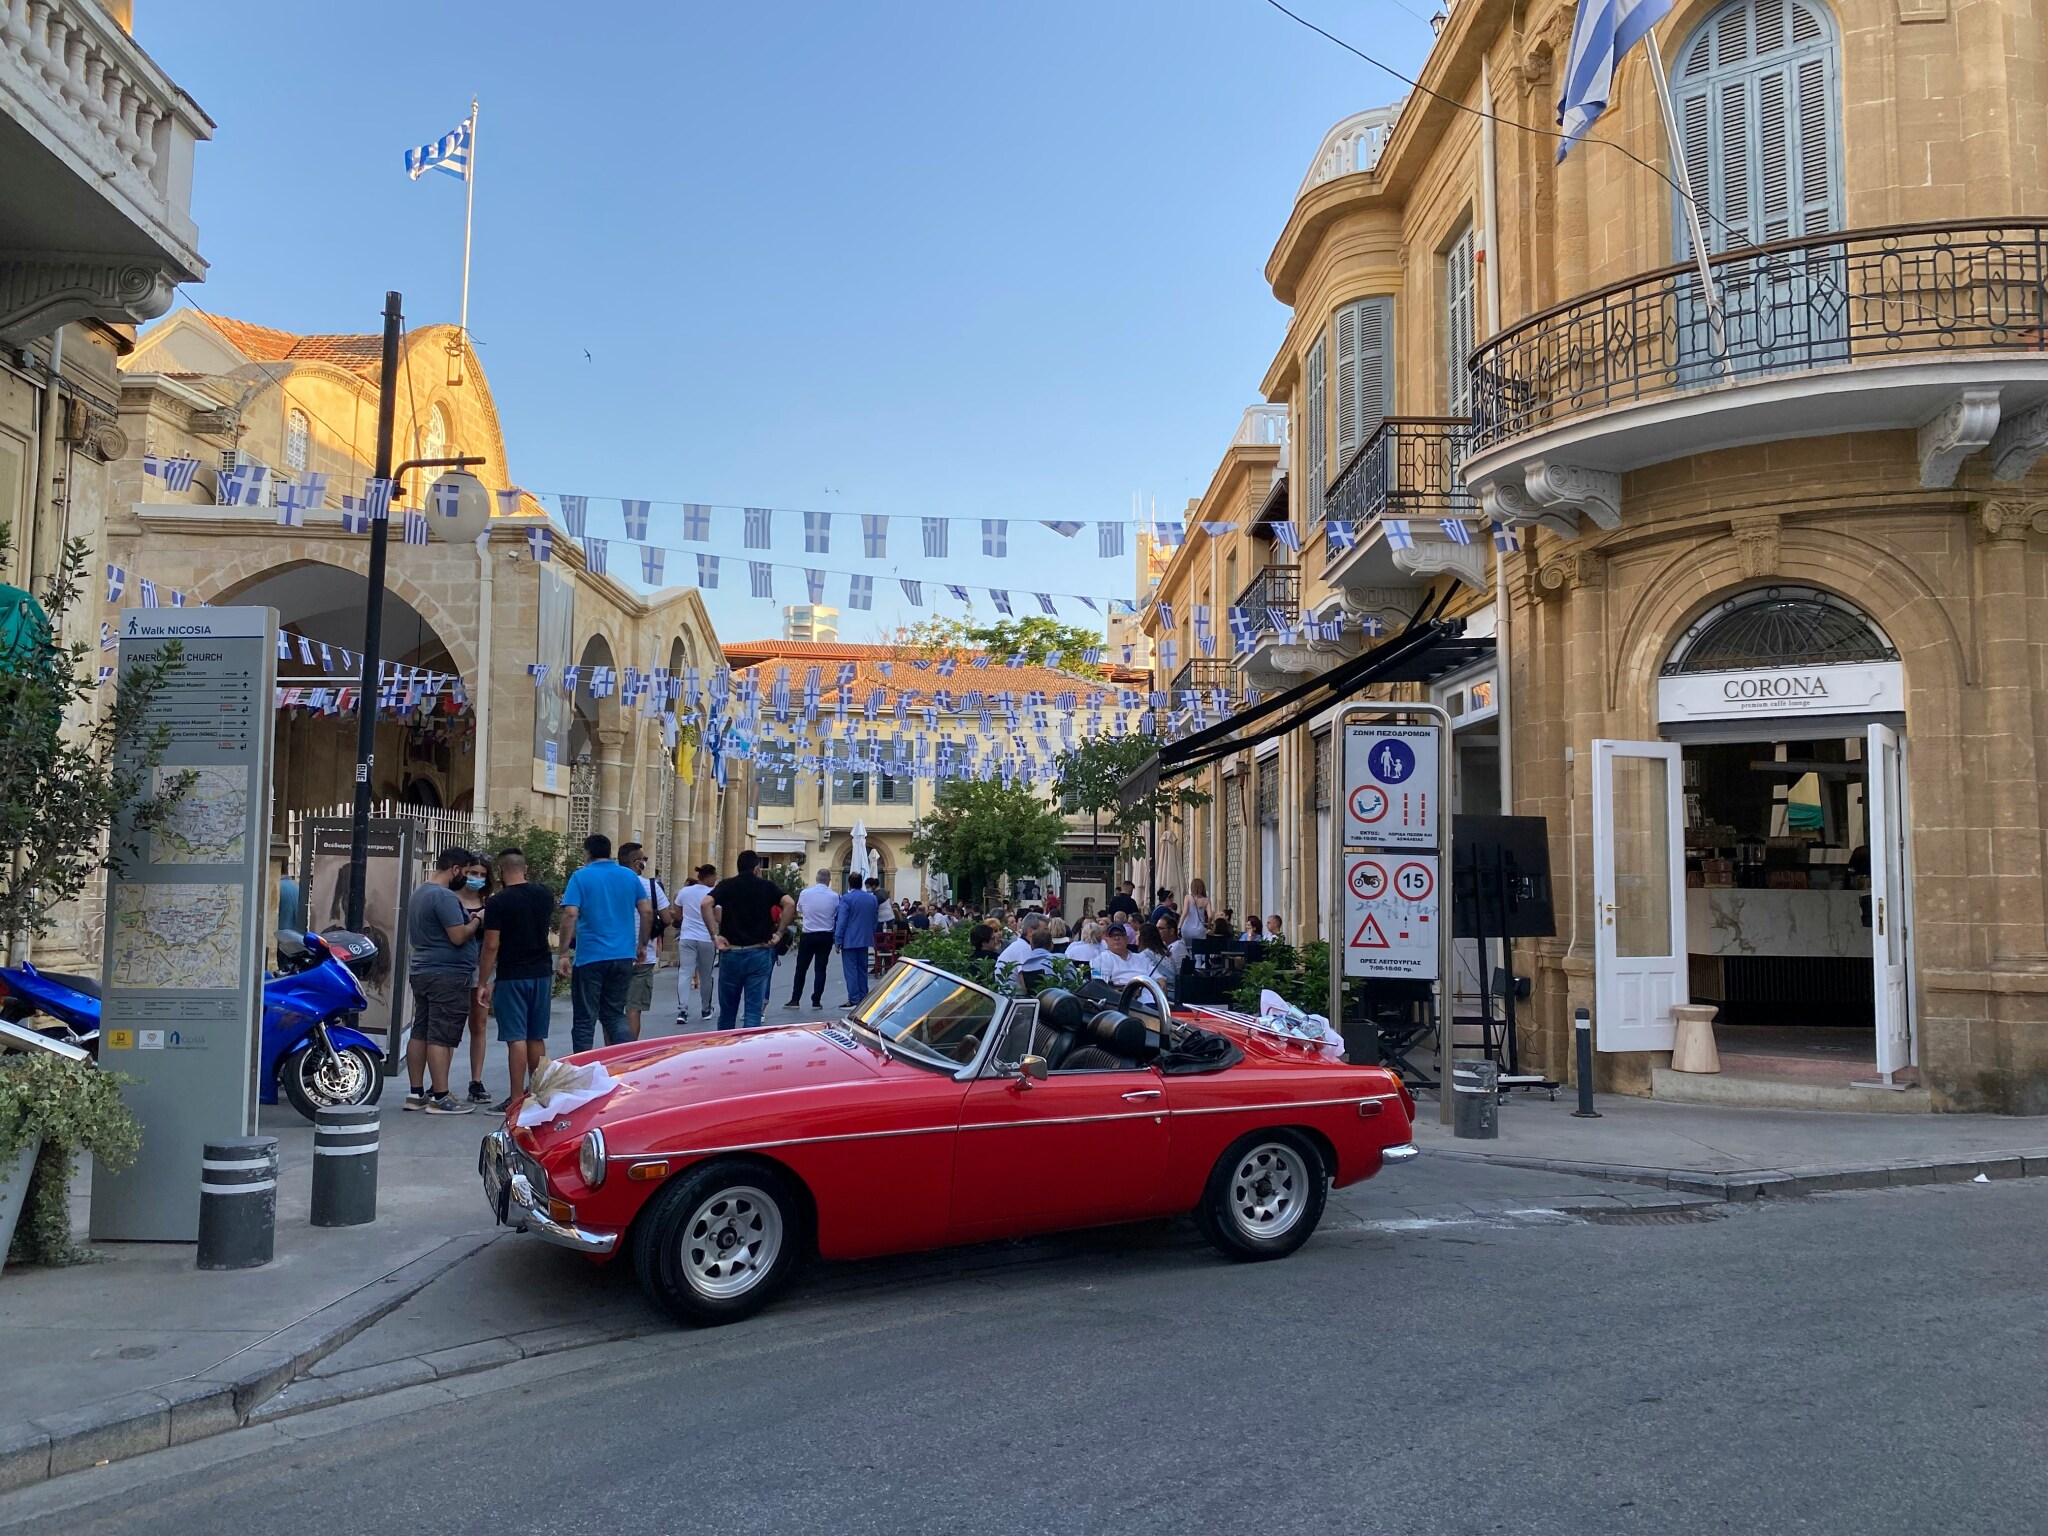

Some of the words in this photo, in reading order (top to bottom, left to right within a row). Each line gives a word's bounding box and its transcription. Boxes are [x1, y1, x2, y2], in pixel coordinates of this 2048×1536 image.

[141, 625, 165, 635] Walk
[167, 625, 212, 635] NICOSIA
[186, 653, 223, 662] CHURCH
[1723, 676, 1828, 699] CORONA
[1741, 701, 1768, 710] premium
[1788, 699, 1811, 707] lounge
[356, 765, 366, 781] BNE
[1402, 873, 1425, 889] 15
